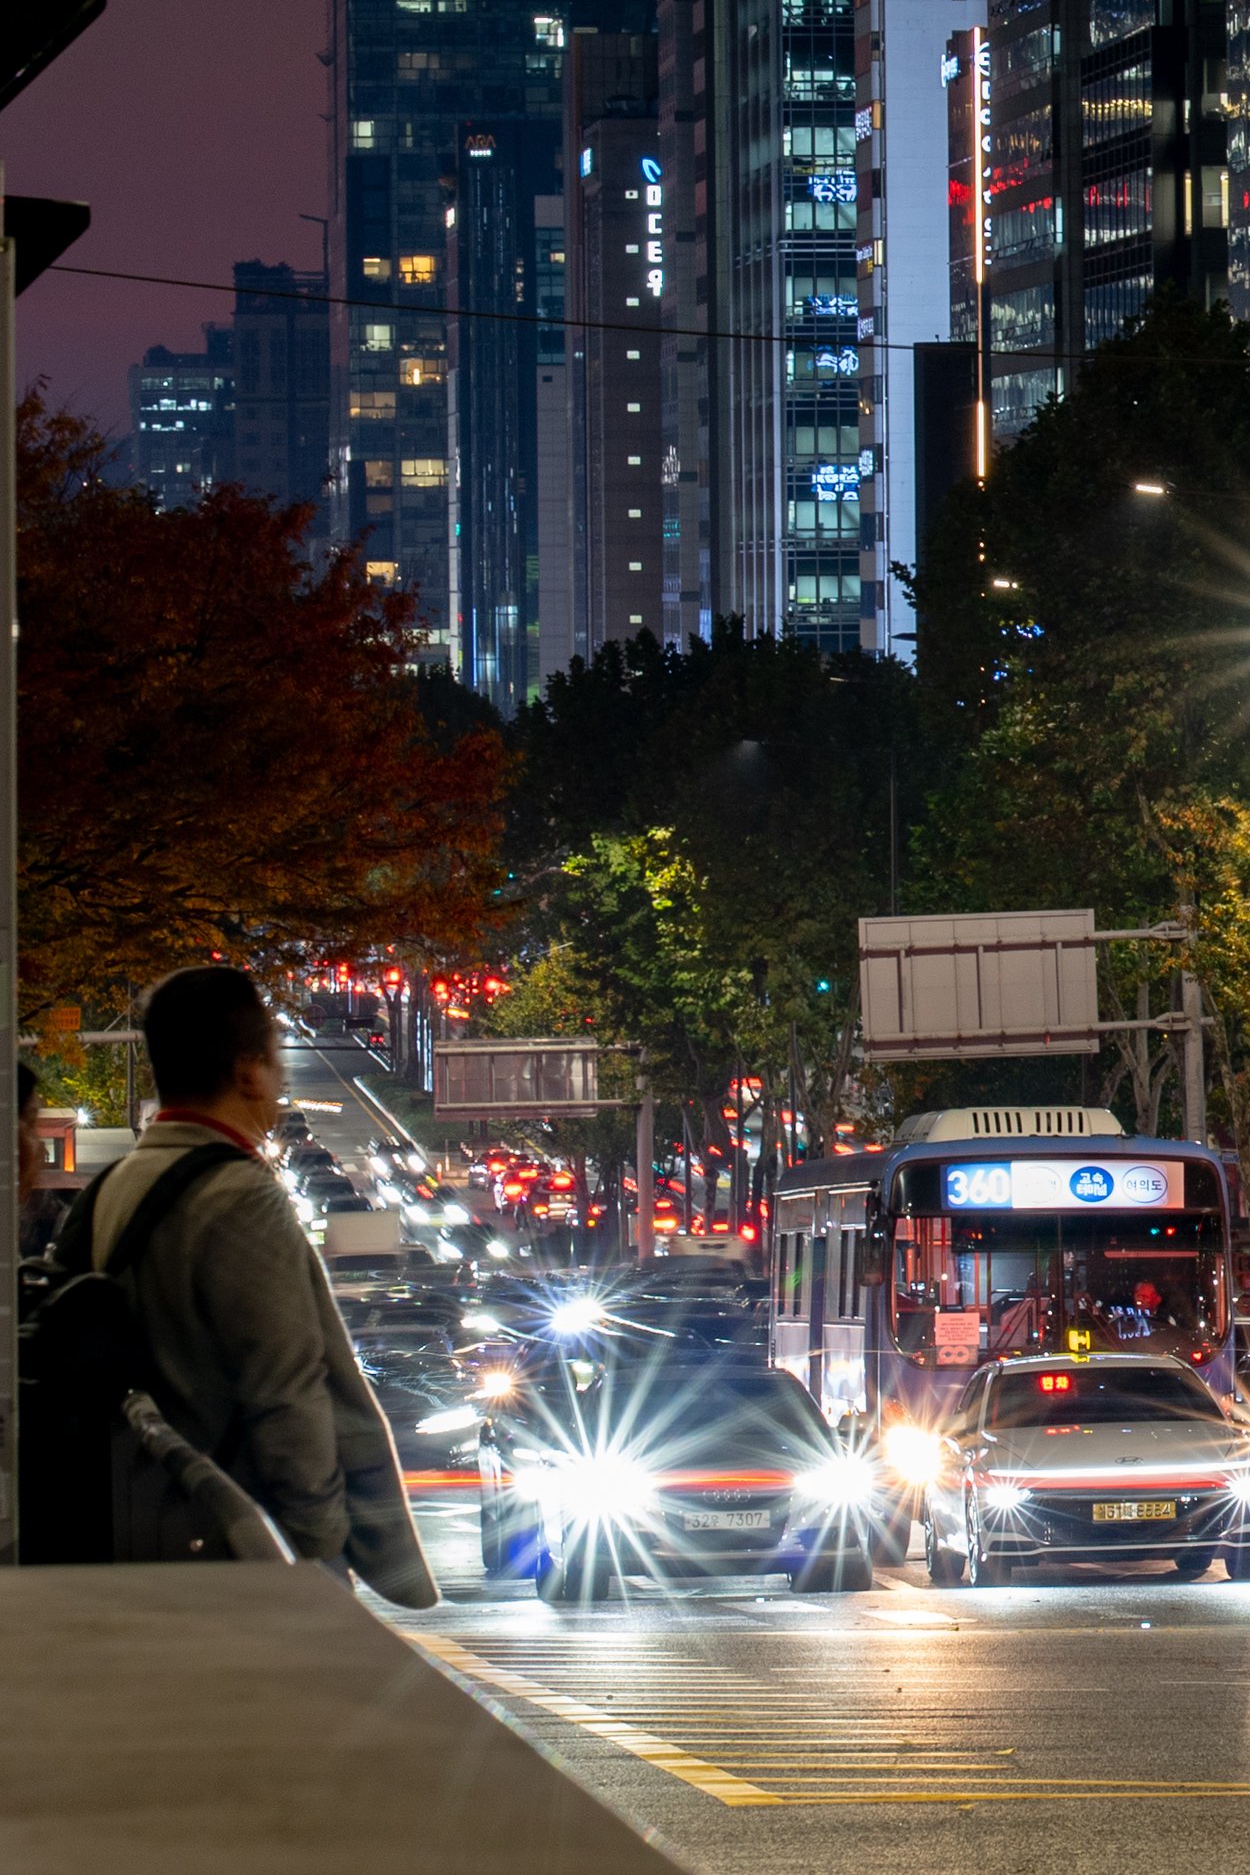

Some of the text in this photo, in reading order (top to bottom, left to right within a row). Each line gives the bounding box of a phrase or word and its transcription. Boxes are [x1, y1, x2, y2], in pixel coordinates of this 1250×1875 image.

[1080, 1172, 1104, 1184] 고속
[947, 1169, 1010, 1204] 360
[1076, 1184, 1107, 1197] 터미널
[726, 1513, 762, 1527] 7307
